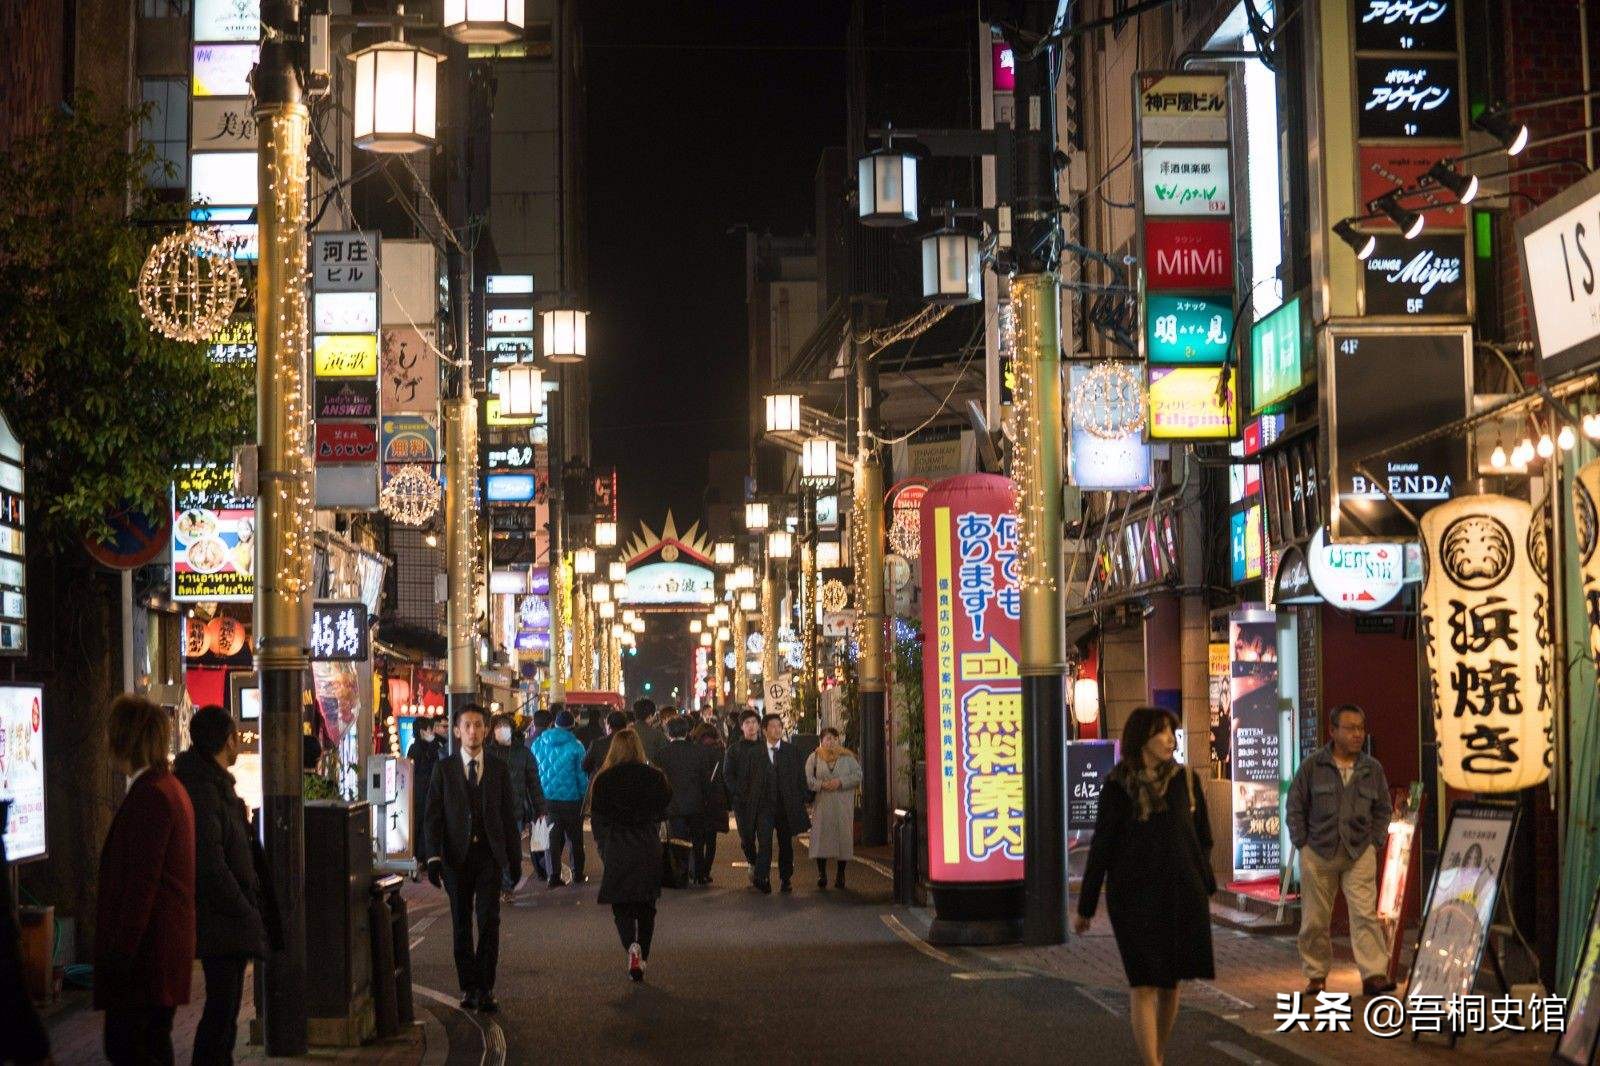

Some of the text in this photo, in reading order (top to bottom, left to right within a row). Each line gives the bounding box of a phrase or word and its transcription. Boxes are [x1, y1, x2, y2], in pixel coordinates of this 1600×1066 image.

[1145, 92, 1225, 112] 神戸屋ビル
[322, 240, 368, 263] 河庄
[1560, 210, 1600, 302] IS
[1157, 248, 1223, 276] MiMi
[1367, 258, 1402, 271] LOUNGE
[327, 267, 364, 282] ビル
[1176, 301, 1206, 312] スナック
[1339, 338, 1359, 355] 4F
[322, 403, 373, 416] ANSWER
[1446, 596, 1524, 775] 浜焼き
